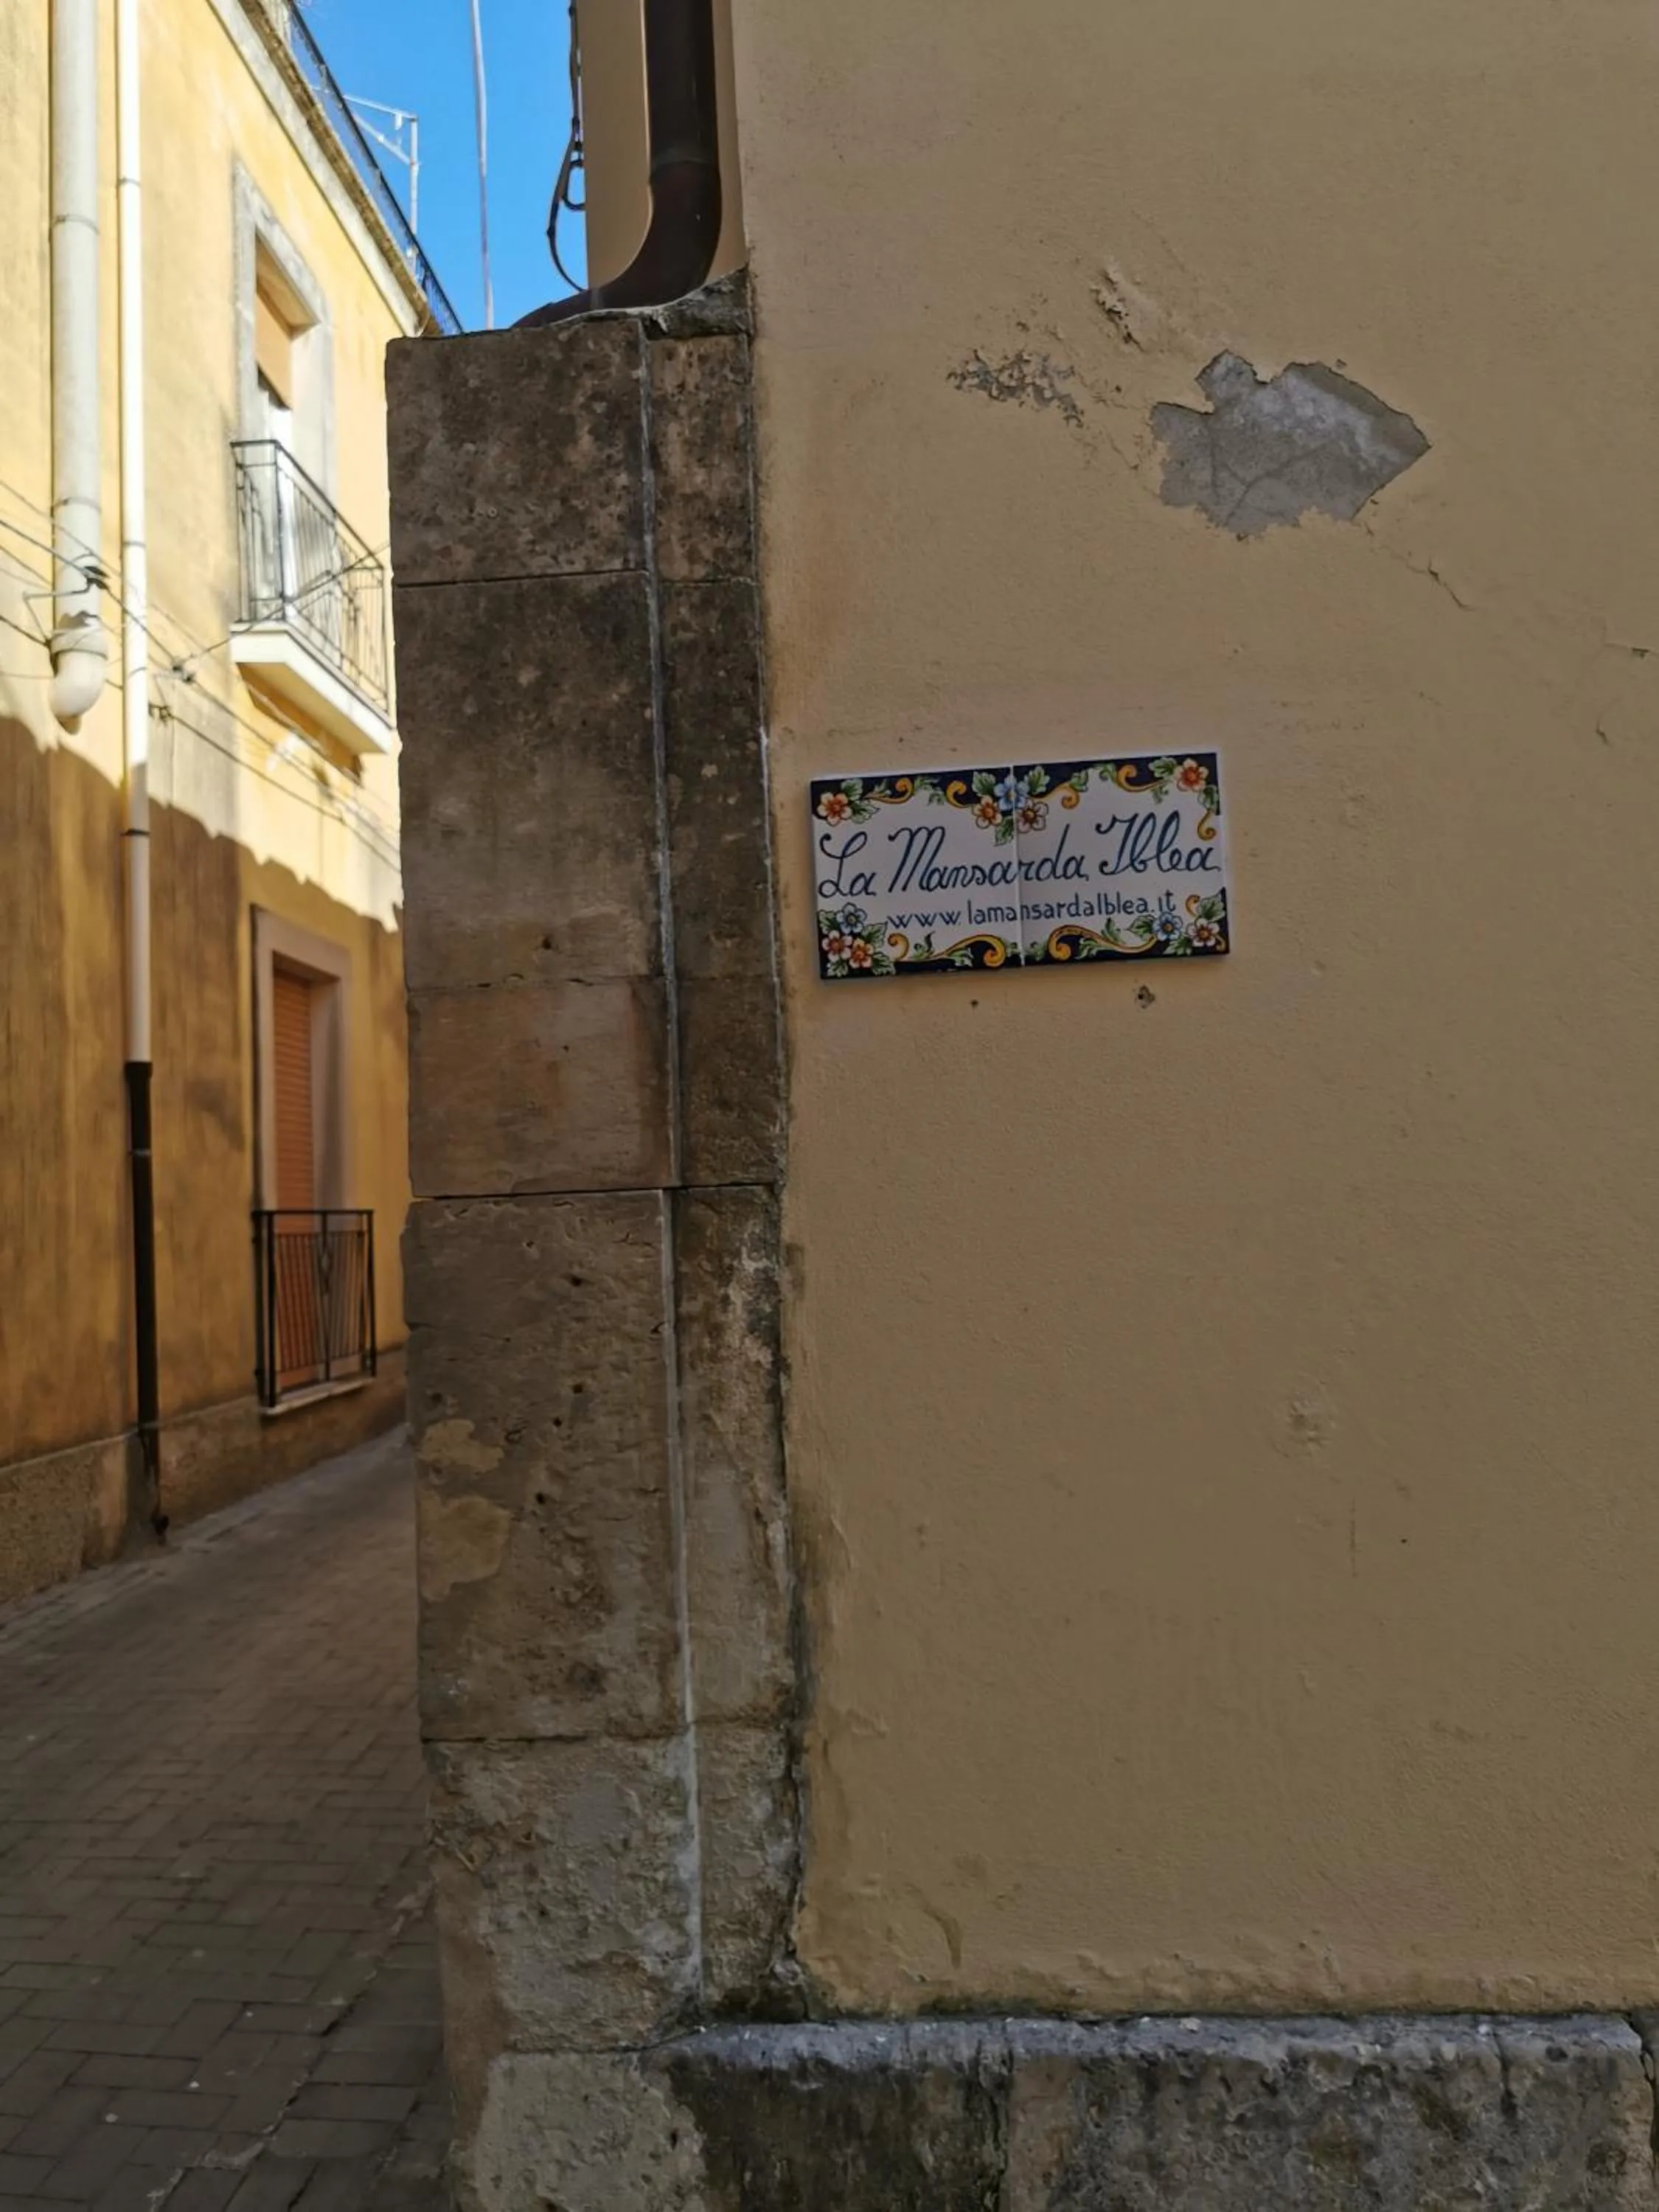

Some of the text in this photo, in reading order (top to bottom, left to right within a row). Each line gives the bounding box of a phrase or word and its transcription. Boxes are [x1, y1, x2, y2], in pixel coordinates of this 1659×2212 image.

[818, 810, 1220, 897] La Mansarda Iblea
